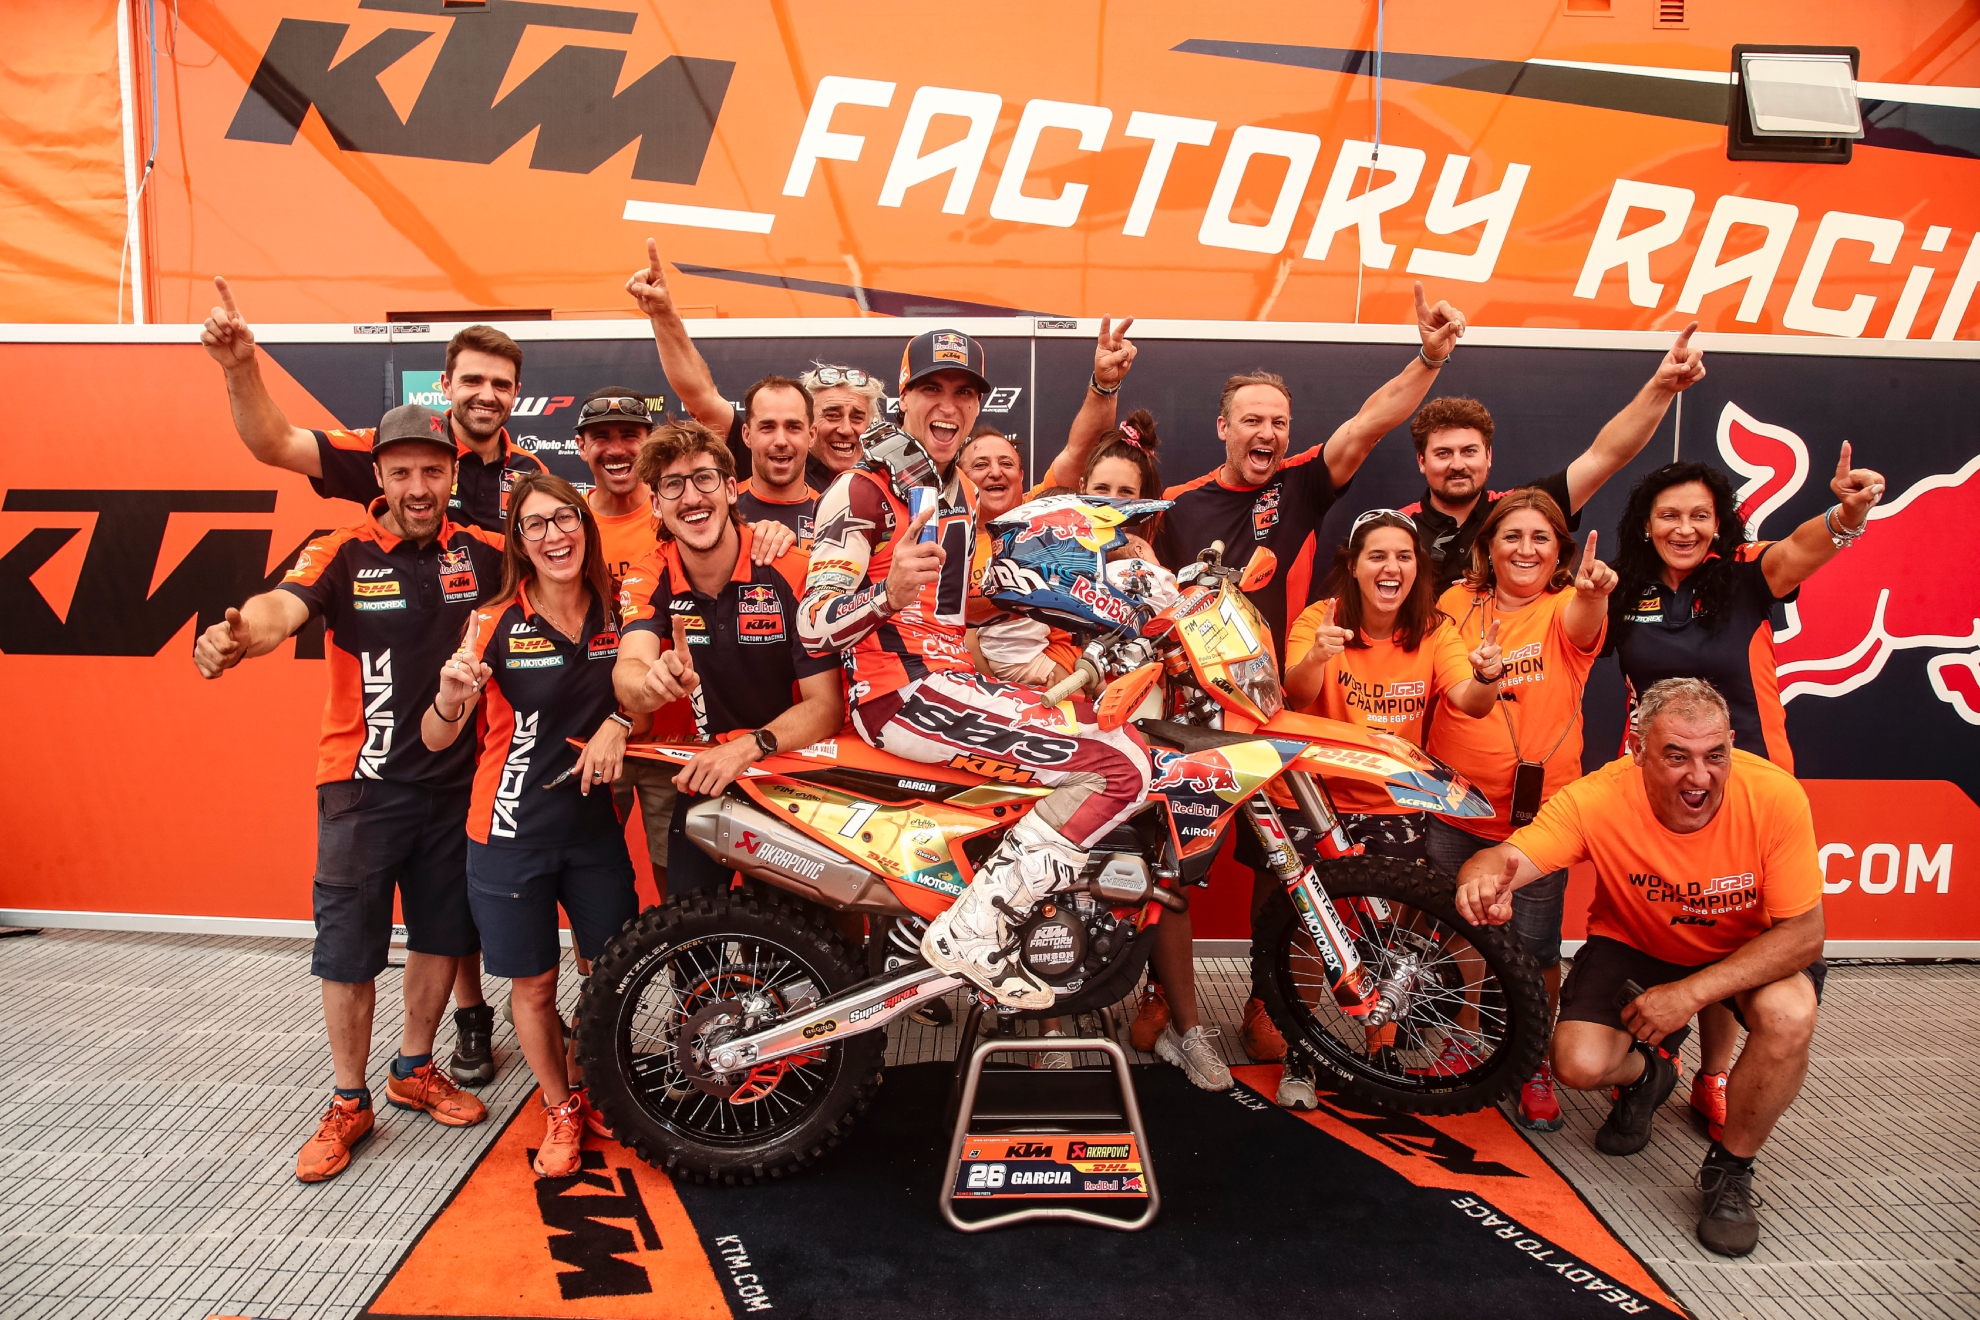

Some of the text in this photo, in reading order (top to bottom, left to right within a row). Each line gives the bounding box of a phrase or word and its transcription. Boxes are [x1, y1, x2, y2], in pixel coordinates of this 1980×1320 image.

[224, 0, 736, 186] KTM
[537, 439, 579, 450] Moto-Ma
[811, 559, 853, 572] DHL
[357, 568, 393, 579] WP
[356, 583, 398, 594] DHL
[448, 576, 470, 589] KTM
[1070, 576, 1110, 613] Red
[363, 600, 405, 610] MOTOREX
[739, 602, 781, 613] Red Bull
[745, 619, 777, 631] KTM
[1218, 594, 1260, 654] 1
[511, 639, 554, 651] DHL
[592, 636, 615, 649] KTM
[740, 633, 784, 643] FACTORY RACING
[520, 655, 562, 668] MOTOREX
[1503, 657, 1544, 680] PION
[1337, 669, 1425, 699] WORLD JG26
[1508, 676, 1524, 688] EGP
[1345, 692, 1427, 714] CHAMPION
[354, 648, 395, 781] ACING
[1366, 713, 1389, 724] 2026
[1390, 713, 1407, 724] EGP
[1319, 745, 1386, 769] DHL
[949, 755, 1036, 784] KTM
[898, 780, 937, 793] GARCIA
[1171, 800, 1219, 818] Red Bull
[1396, 797, 1444, 812] ACERBIS
[838, 800, 882, 840] 1
[1181, 826, 1217, 838] AIROH
[756, 842, 826, 881] AKRAPOVIČ
[866, 850, 902, 872] DHL
[1628, 871, 1755, 897] WORLD JG26
[1646, 887, 1757, 909] CHAMPION
[1309, 873, 1352, 949] METZELER
[1682, 904, 1708, 915] 2026
[1711, 904, 1733, 915] EGP
[1669, 914, 1718, 928] KTM
[1034, 926, 1068, 939] KTM
[1030, 935, 1074, 949] FACTORY
[1302, 910, 1344, 972] MOTOREX
[1029, 950, 1075, 962] HINSON
[615, 941, 670, 996] METZELER
[849, 983, 920, 1025] Supersprox
[1300, 1038, 1355, 1083] METZELER
[1005, 1142, 1053, 1158] KTM
[1086, 1144, 1129, 1158] AKRAPOVIČ
[1092, 1164, 1128, 1172] DHL
[967, 1163, 1072, 1189] 26 GARCIA
[1084, 1181, 1119, 1191] Red Bull
[526, 1147, 664, 1301] KTM
[715, 1233, 774, 1312] KTM.COM
